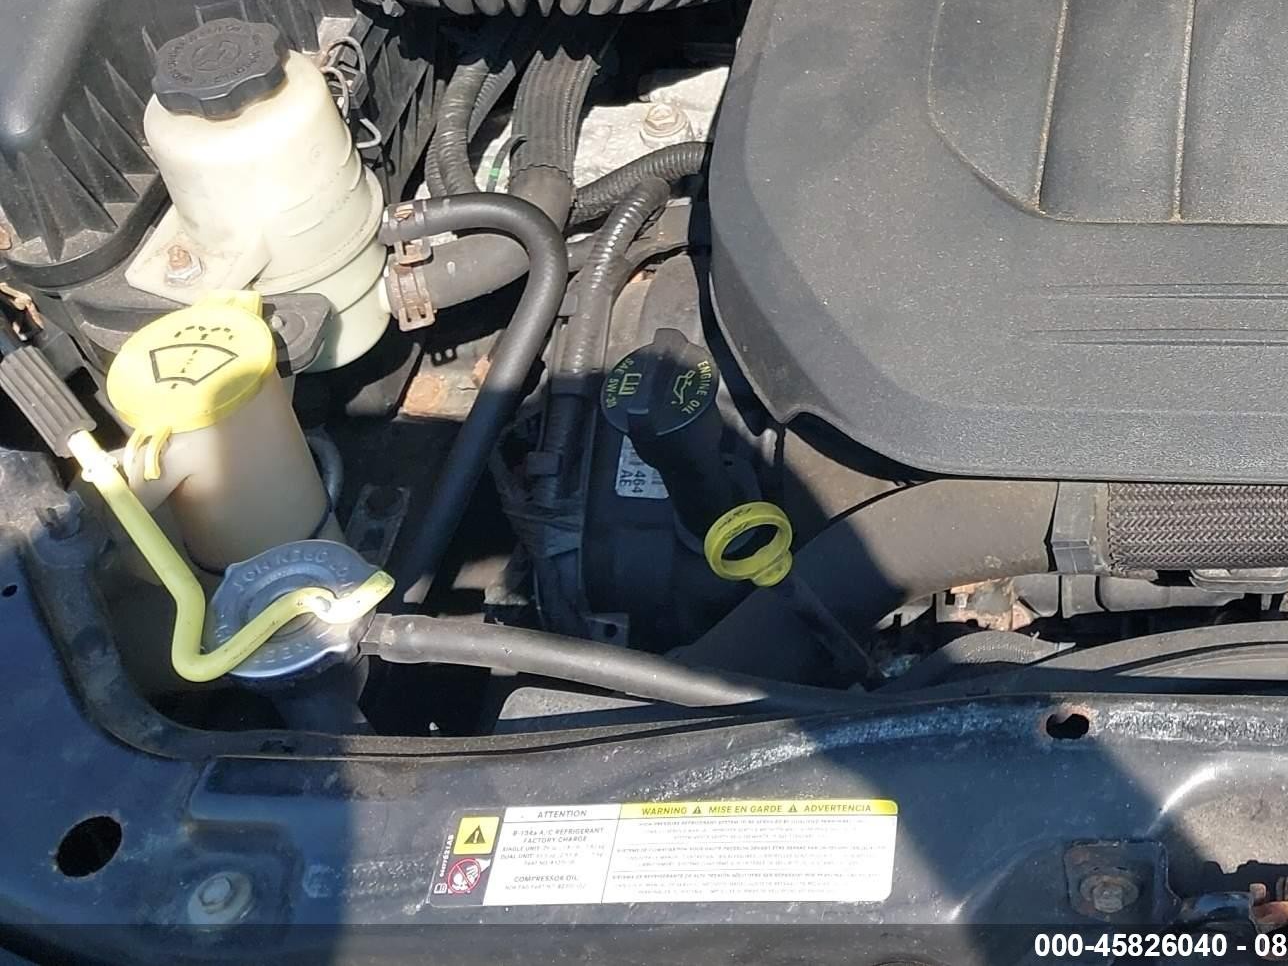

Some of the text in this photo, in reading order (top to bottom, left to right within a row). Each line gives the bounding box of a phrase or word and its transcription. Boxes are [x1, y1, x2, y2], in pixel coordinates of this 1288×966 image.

[614, 358, 635, 376] SAE
[682, 360, 712, 414] ENGINE OIL
[537, 810, 587, 819] ATTENTION
[641, 804, 872, 816] WARNING MISE EN GARDE ADVERTENCIA
[523, 836, 557, 844] FACTORY
